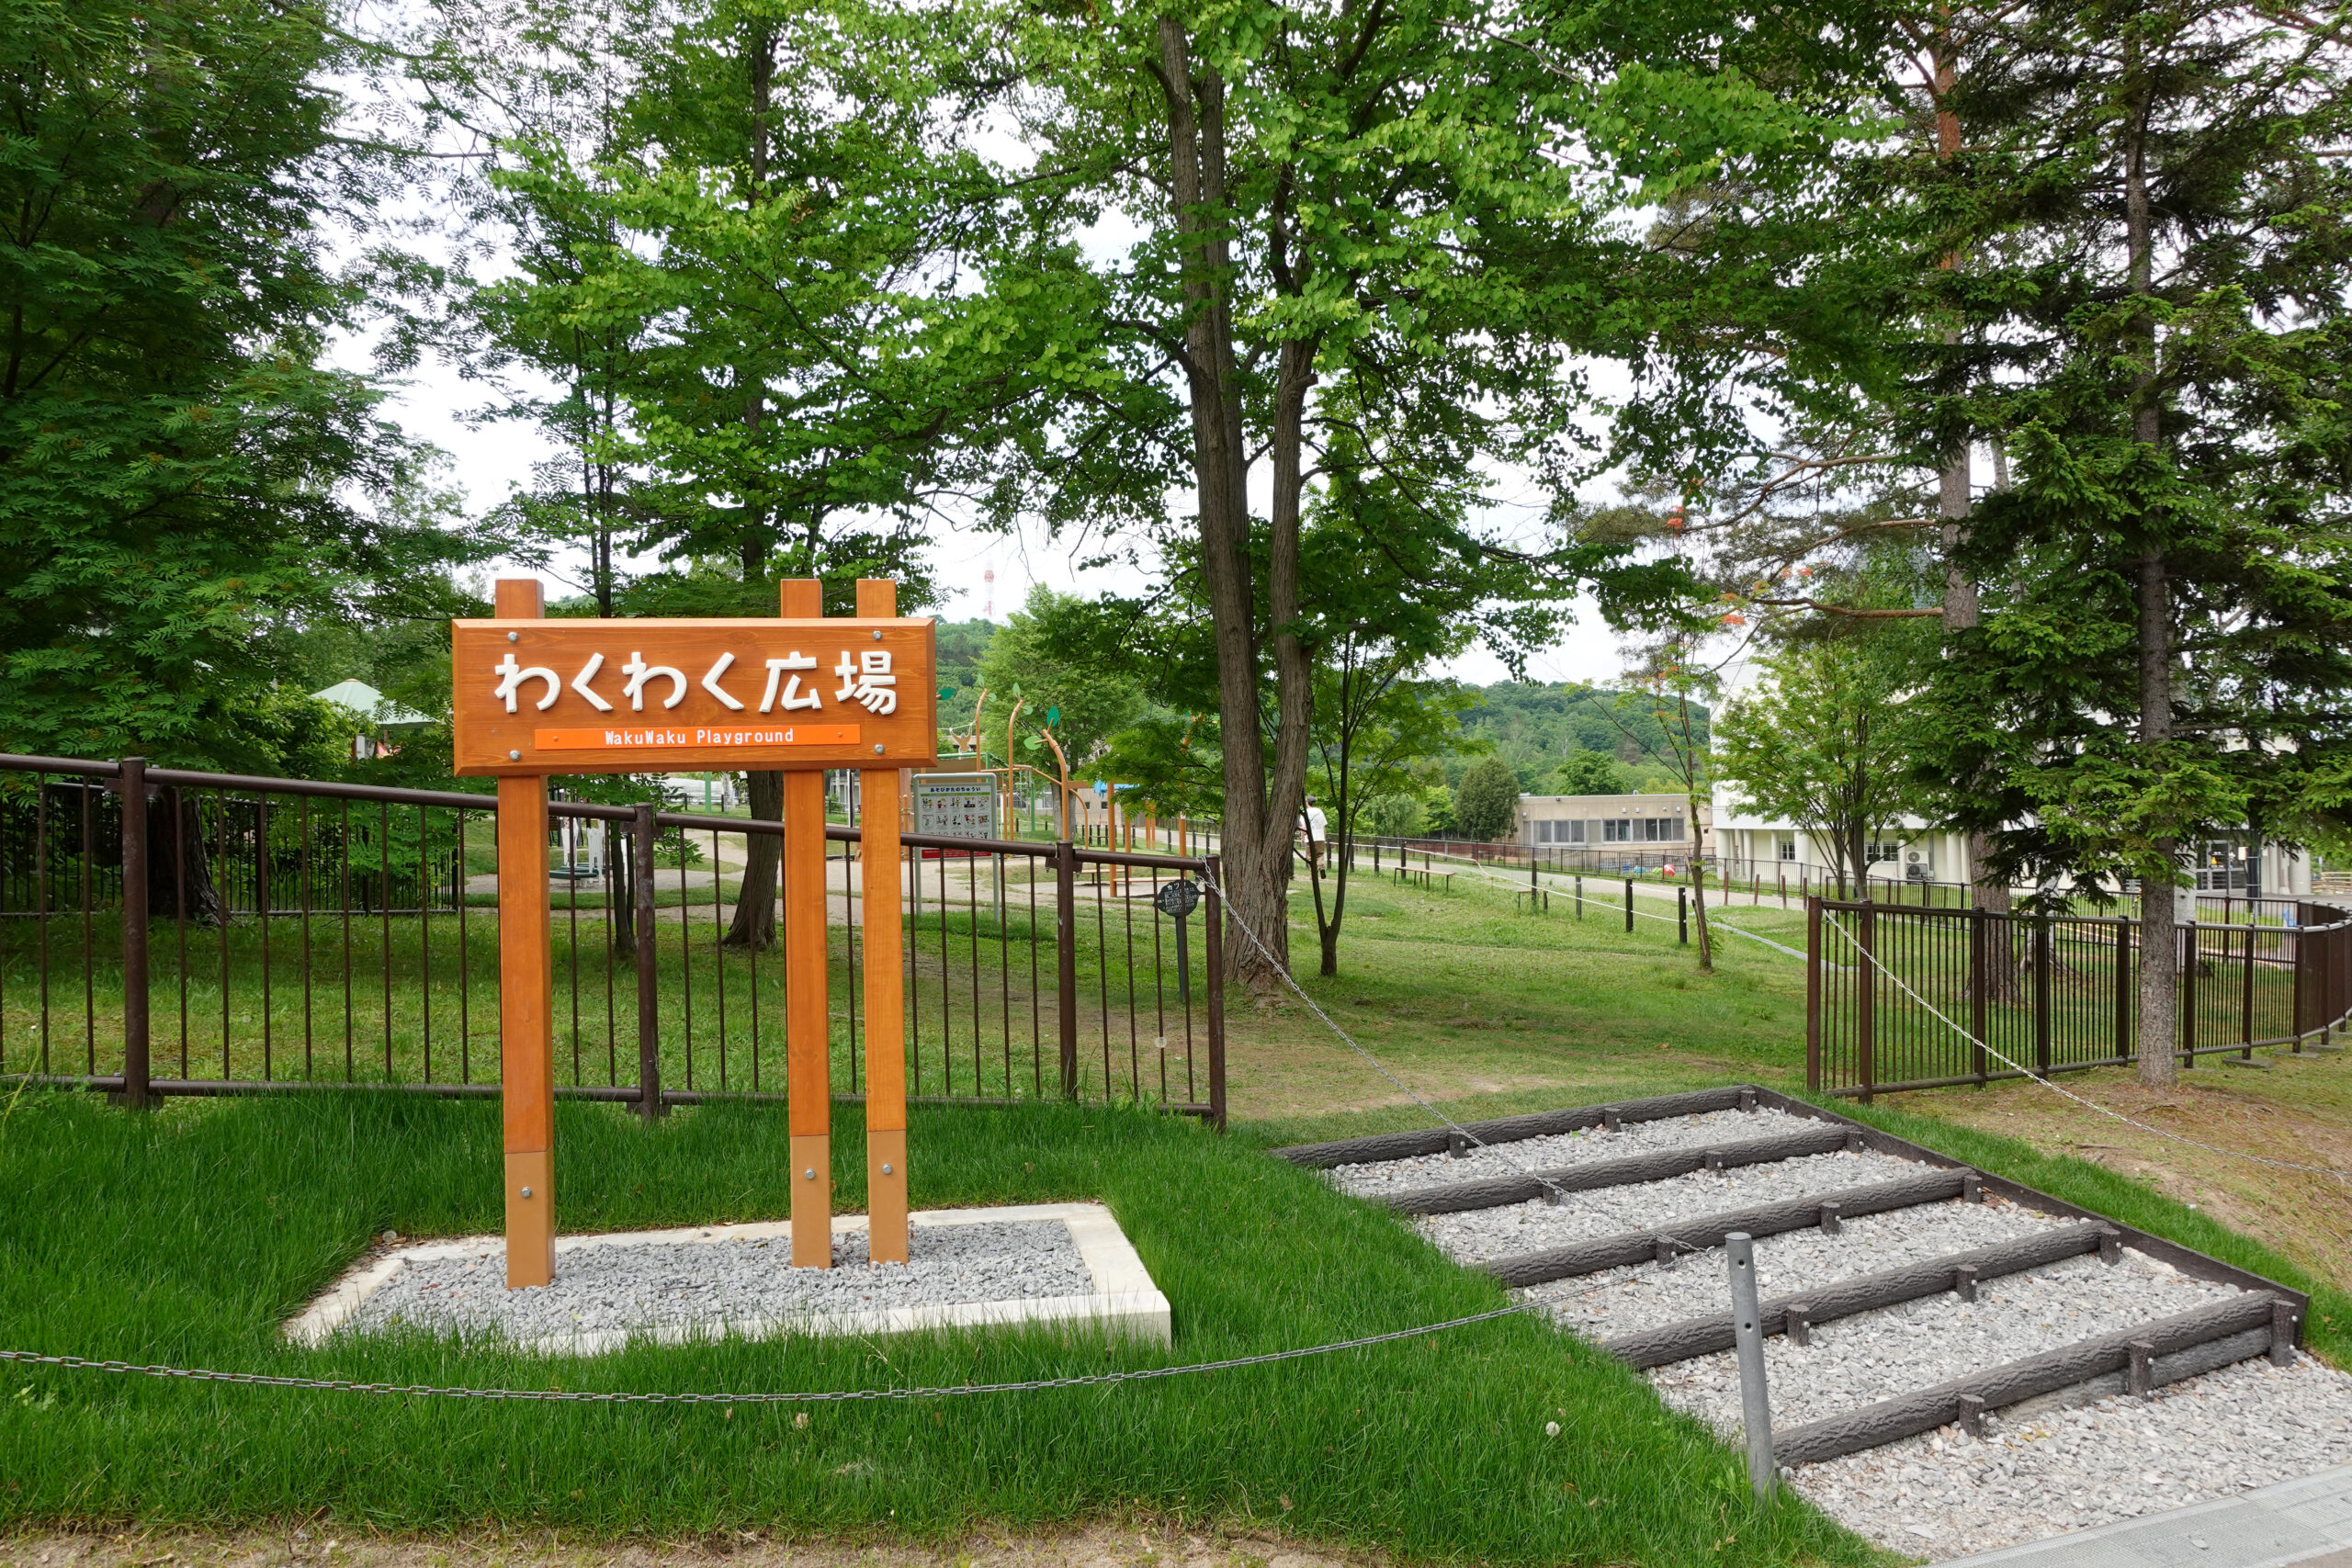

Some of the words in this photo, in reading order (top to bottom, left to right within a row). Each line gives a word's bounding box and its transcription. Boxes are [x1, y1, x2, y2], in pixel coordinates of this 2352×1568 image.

[494, 650, 897, 716] わくわく広場
[605, 730, 686, 745] WakuWaku
[696, 728, 794, 745] Playground
